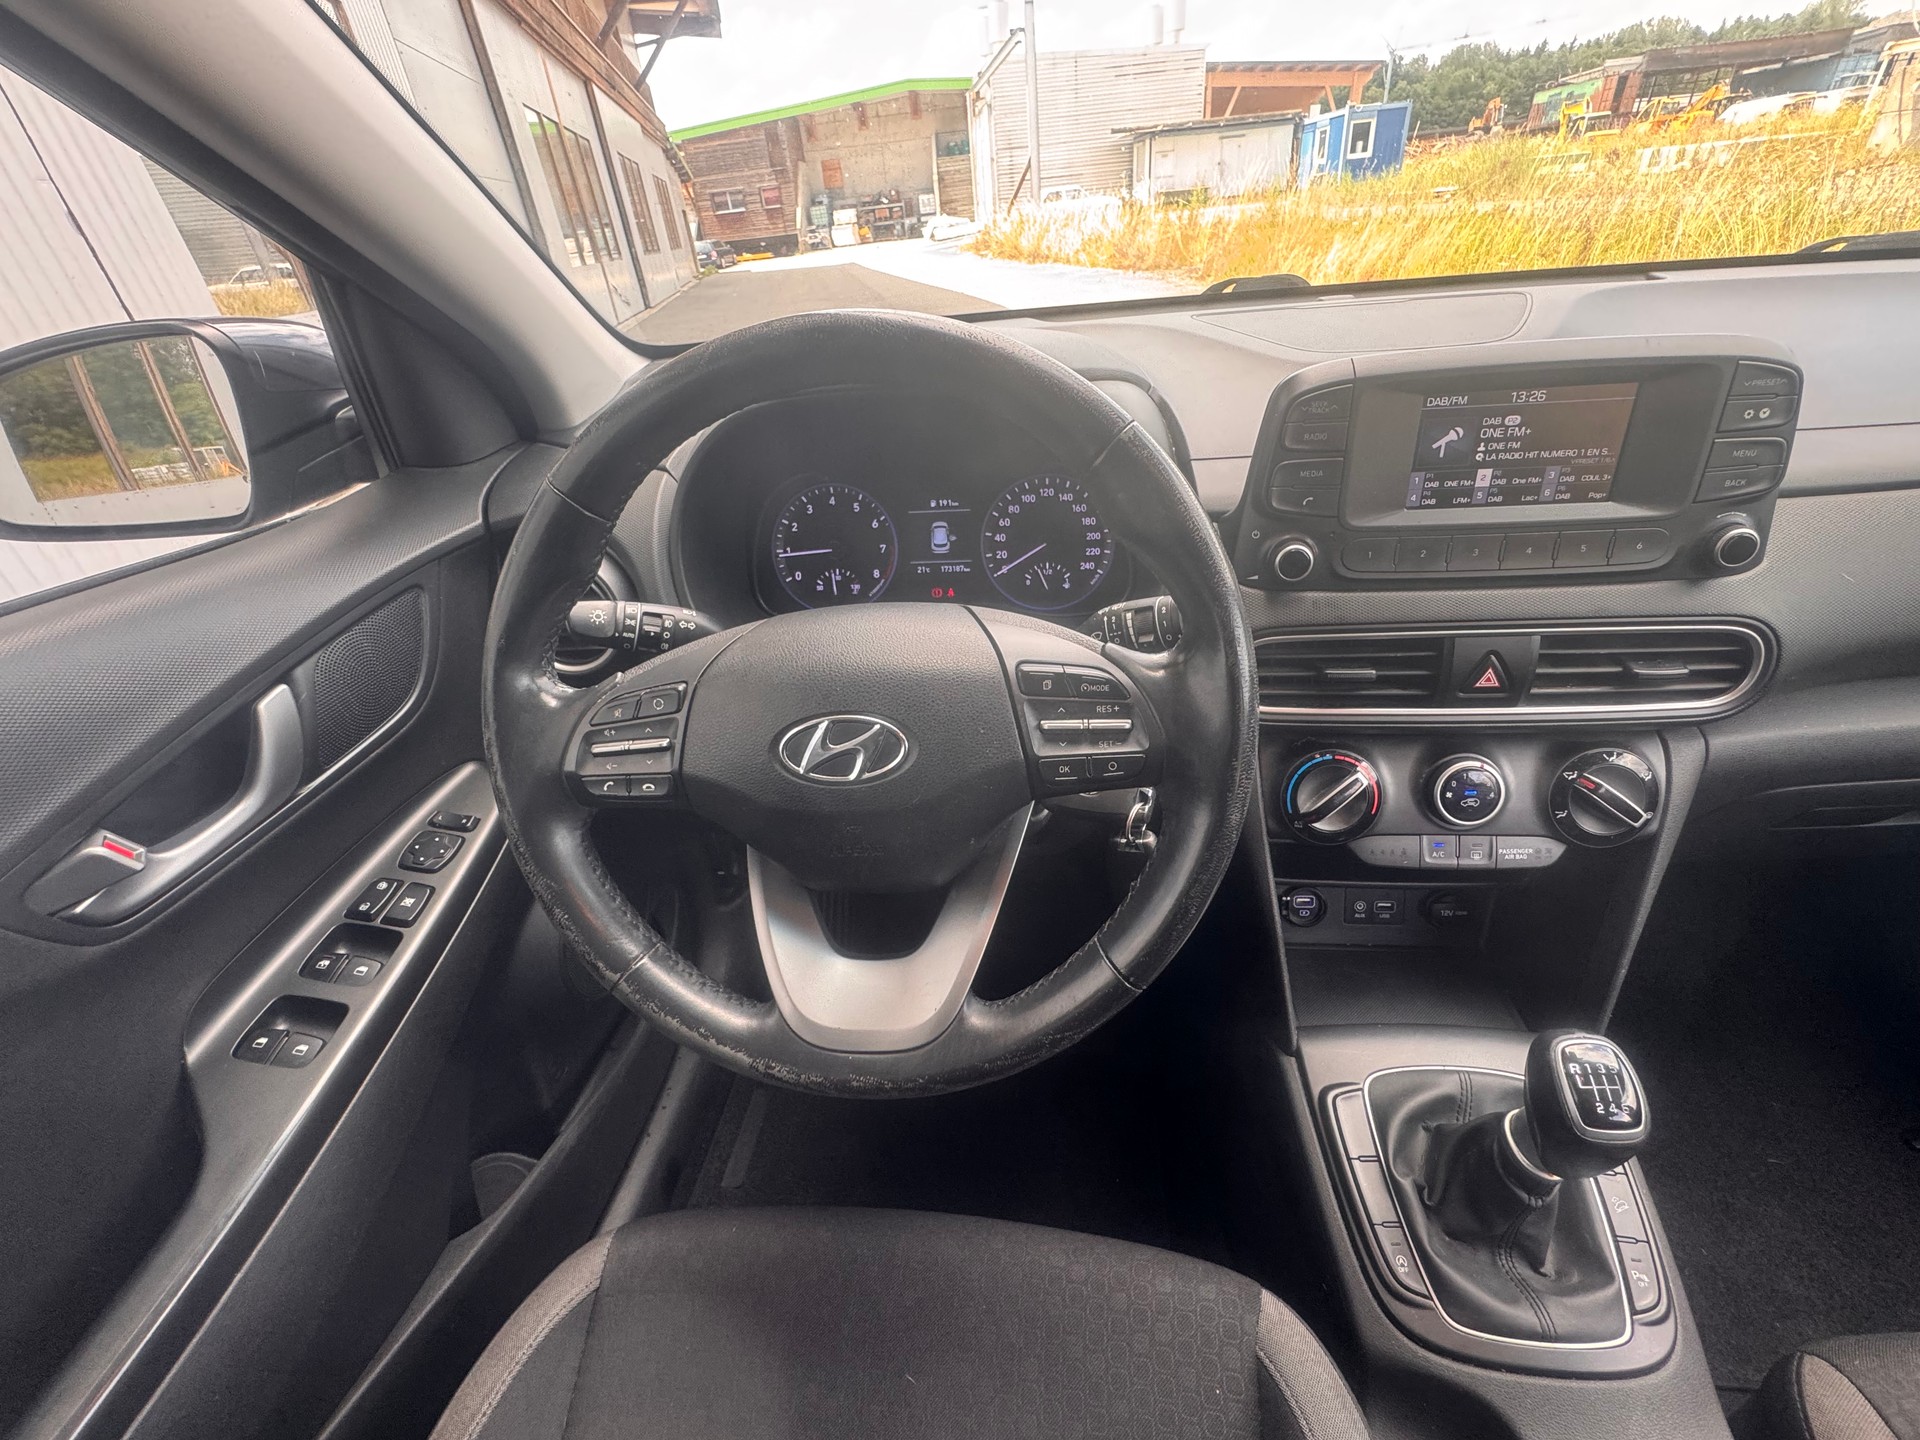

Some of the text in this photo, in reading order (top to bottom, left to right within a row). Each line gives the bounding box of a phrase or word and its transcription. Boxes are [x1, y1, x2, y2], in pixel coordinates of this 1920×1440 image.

[1426, 395, 1468, 407] DAB/FM
[1511, 390, 1547, 403] 13:26
[1482, 416, 1502, 426] DAB
[1303, 432, 1328, 441] RADIO
[1480, 426, 1532, 438] ONE FM+
[1487, 441, 1521, 450] ONE FM
[1485, 453, 1497, 461] LA
[1498, 452, 1524, 460] RADIO
[1525, 450, 1539, 459] HIT
[1540, 449, 1578, 458] NUMERO
[1587, 448, 1601, 456] EN
[1732, 449, 1757, 457] MENU
[1299, 470, 1323, 478] MEDIA
[1548, 471, 1555, 479] 3
[1559, 475, 1575, 483] DAB
[1724, 478, 1748, 487] BACK
[1039, 488, 1054, 496] 120
[1476, 491, 1483, 499] 5
[1544, 488, 1551, 496] 6
[1588, 491, 1607, 499] Pop+
[829, 496, 836, 505] 4
[1021, 494, 1036, 502] 100
[1059, 493, 1073, 501] 140
[1487, 495, 1503, 503] DAB
[806, 504, 813, 514] 3
[853, 502, 860, 512] 5
[1008, 505, 1020, 513] 80
[1072, 504, 1087, 512] 160
[871, 519, 879, 529] 6
[998, 518, 1011, 527] 60
[1081, 517, 1096, 525] 180
[791, 522, 798, 532] 2
[994, 533, 1006, 542] 40
[1086, 532, 1101, 540] 200
[880, 544, 887, 553] 7
[1580, 544, 1587, 552] 5
[1636, 541, 1643, 550] 6
[996, 550, 1008, 559] 20
[1085, 547, 1101, 556] 220
[1420, 549, 1426, 558] 2
[1472, 548, 1479, 557] 3
[1525, 546, 1532, 555] 4
[1080, 562, 1095, 570] 240
[795, 571, 802, 581] 0
[873, 569, 880, 578] 8
[1090, 684, 1110, 692] MODE
[1096, 705, 1112, 713] RES
[1059, 765, 1071, 773] OK
[1568, 1063, 1581, 1074] R
[1584, 1063, 1592, 1074] 1
[1596, 1063, 1606, 1074] 3
[1595, 1102, 1605, 1114] 2
[1609, 1103, 1617, 1114] 4
